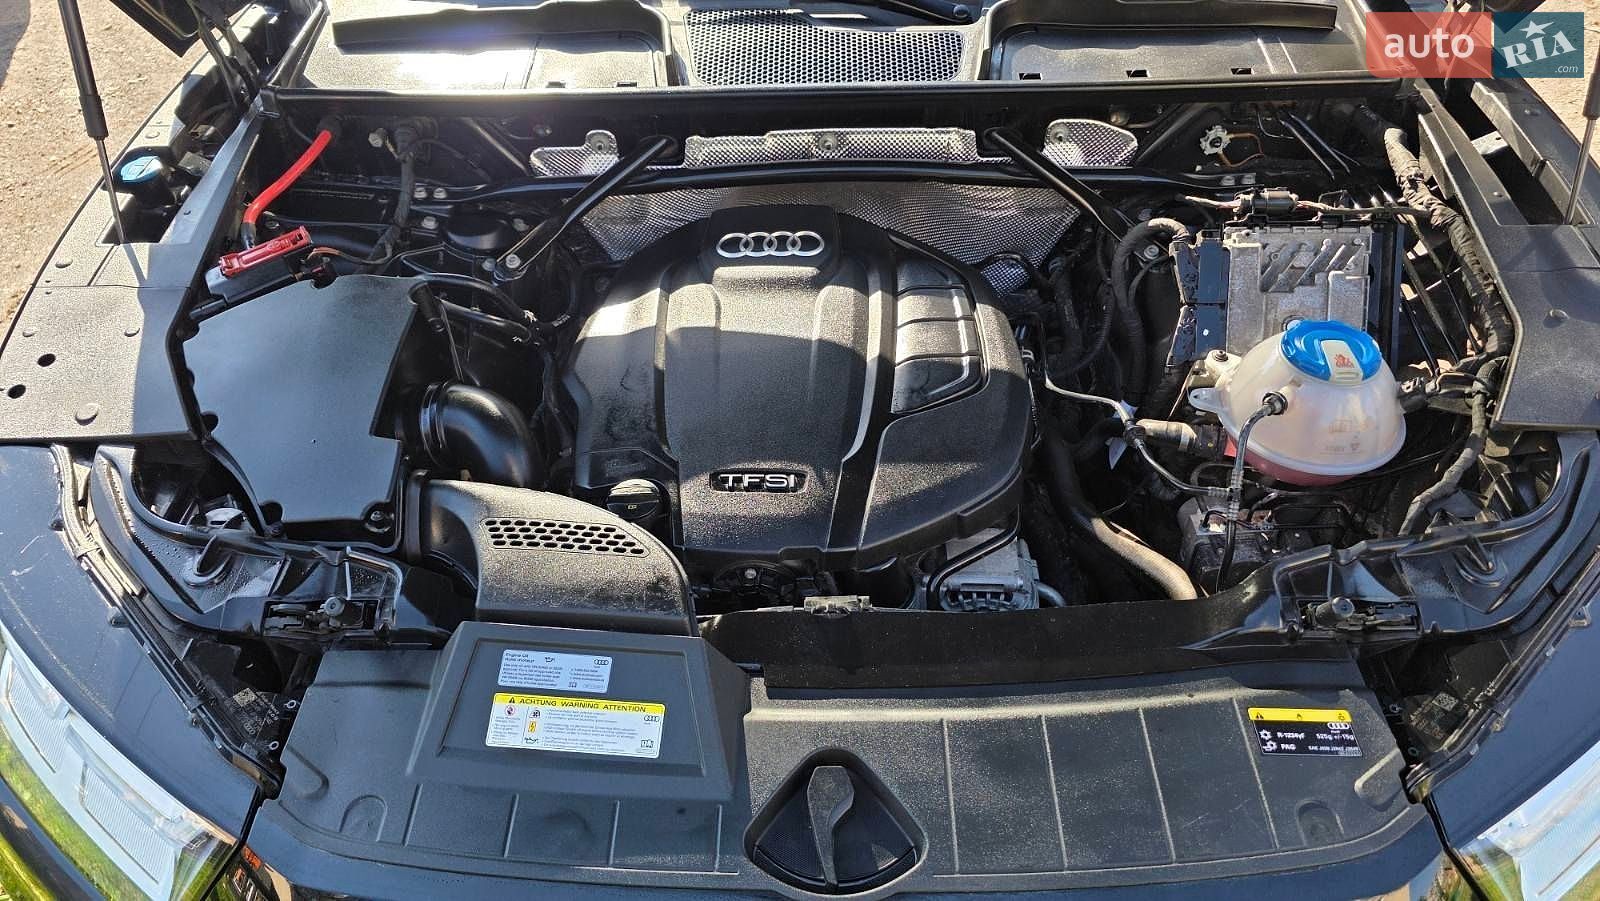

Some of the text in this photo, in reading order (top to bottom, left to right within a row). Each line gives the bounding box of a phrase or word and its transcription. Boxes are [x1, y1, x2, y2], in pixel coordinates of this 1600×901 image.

[719, 473, 796, 488] TFSI
[520, 698, 647, 713] ACHTUNG WARNING ATTENTION
[1280, 743, 1297, 751] PAG
